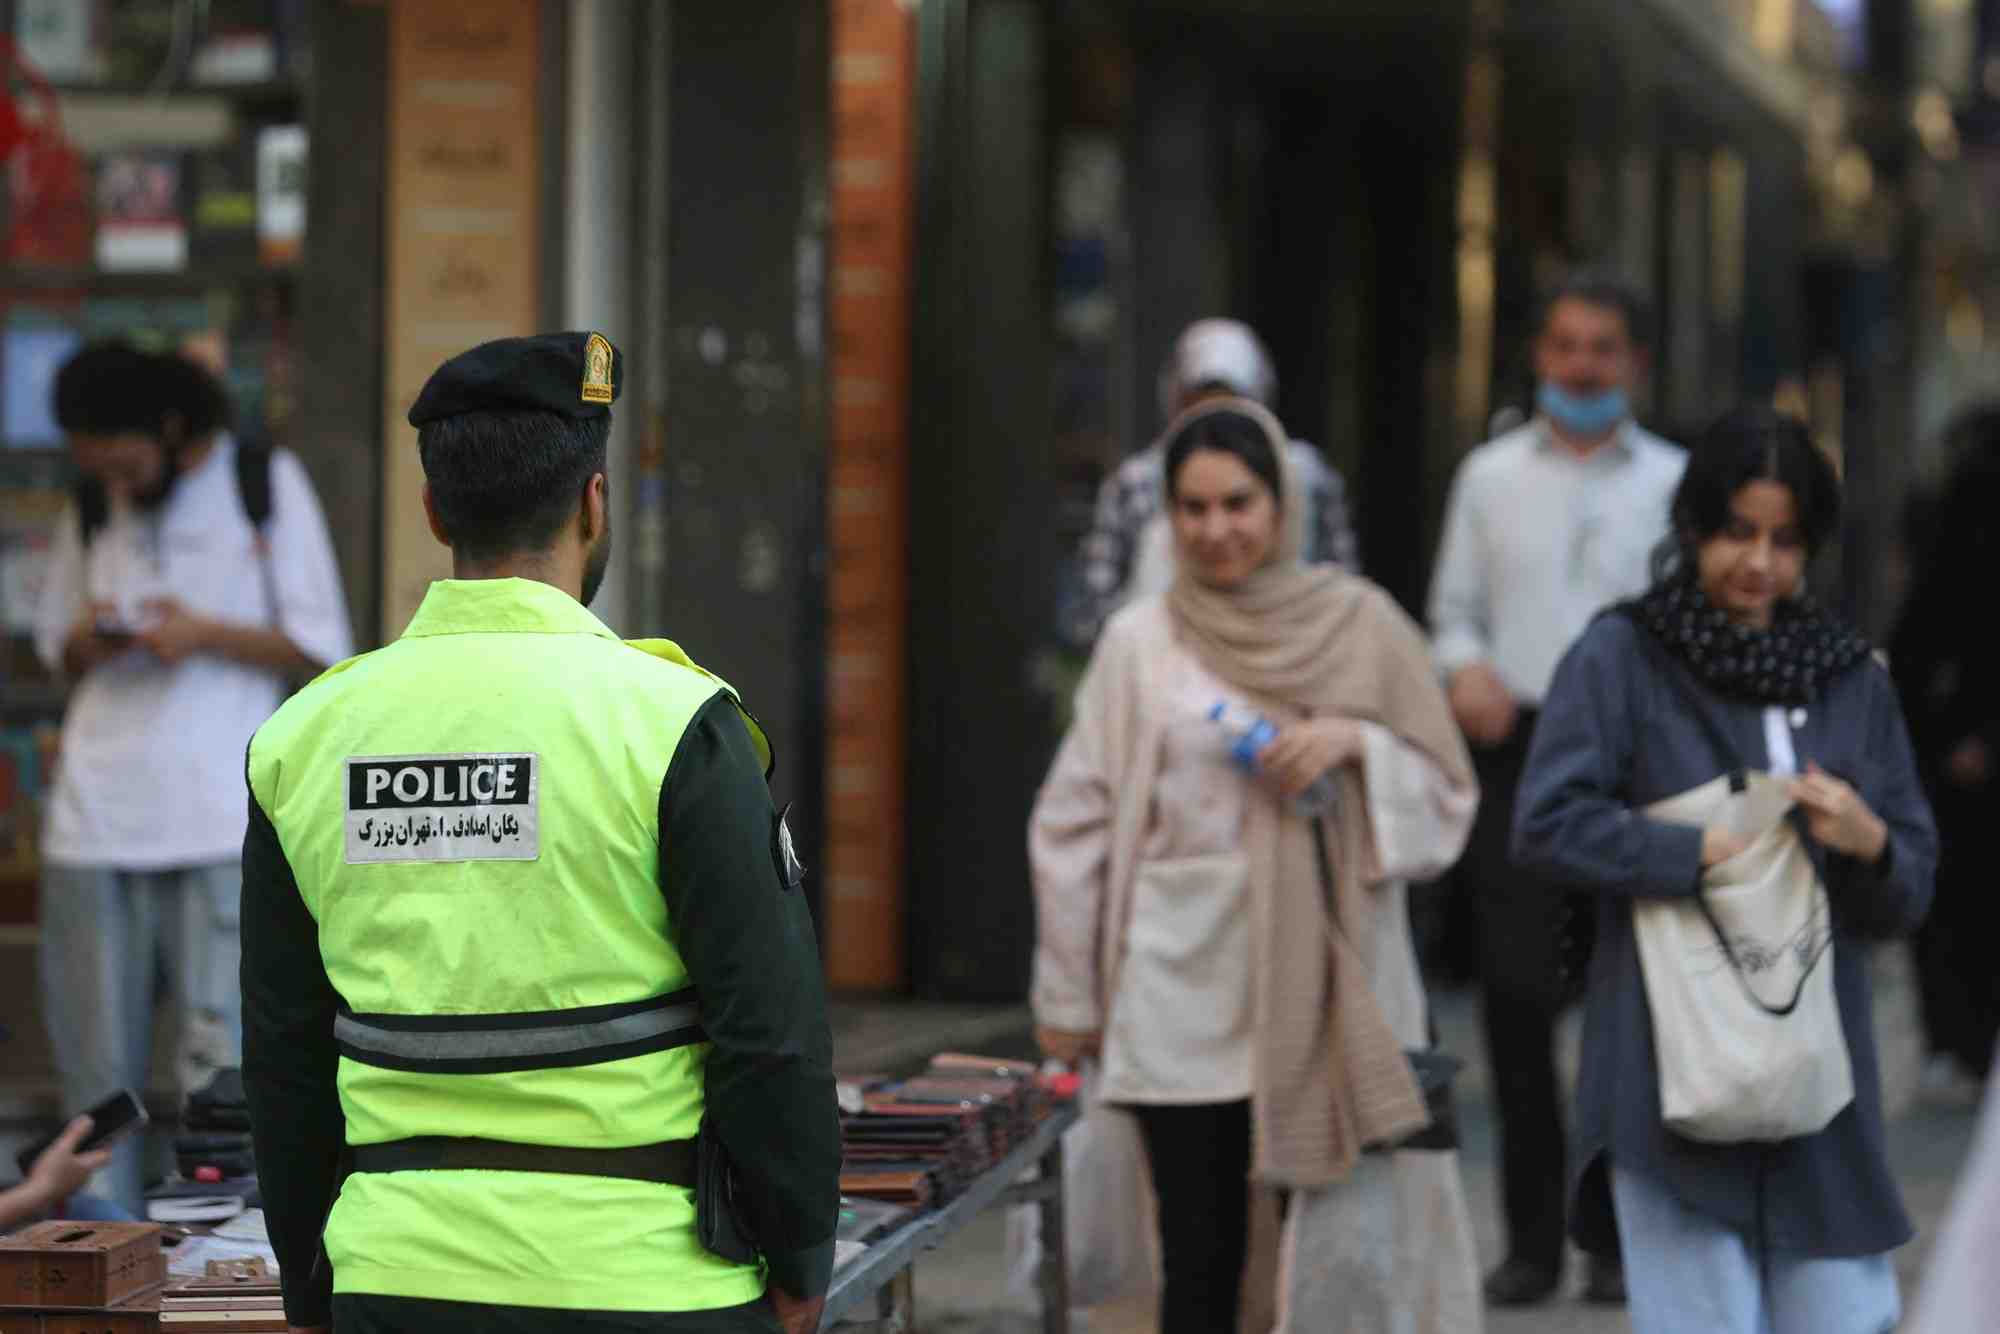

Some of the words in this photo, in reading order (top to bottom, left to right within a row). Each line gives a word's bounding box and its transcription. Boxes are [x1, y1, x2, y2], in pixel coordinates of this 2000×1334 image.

[366, 763, 517, 804] POLICE
[358, 819, 394, 847] بزرگ
[395, 815, 431, 846] تهران
[491, 813, 519, 843] یگان
